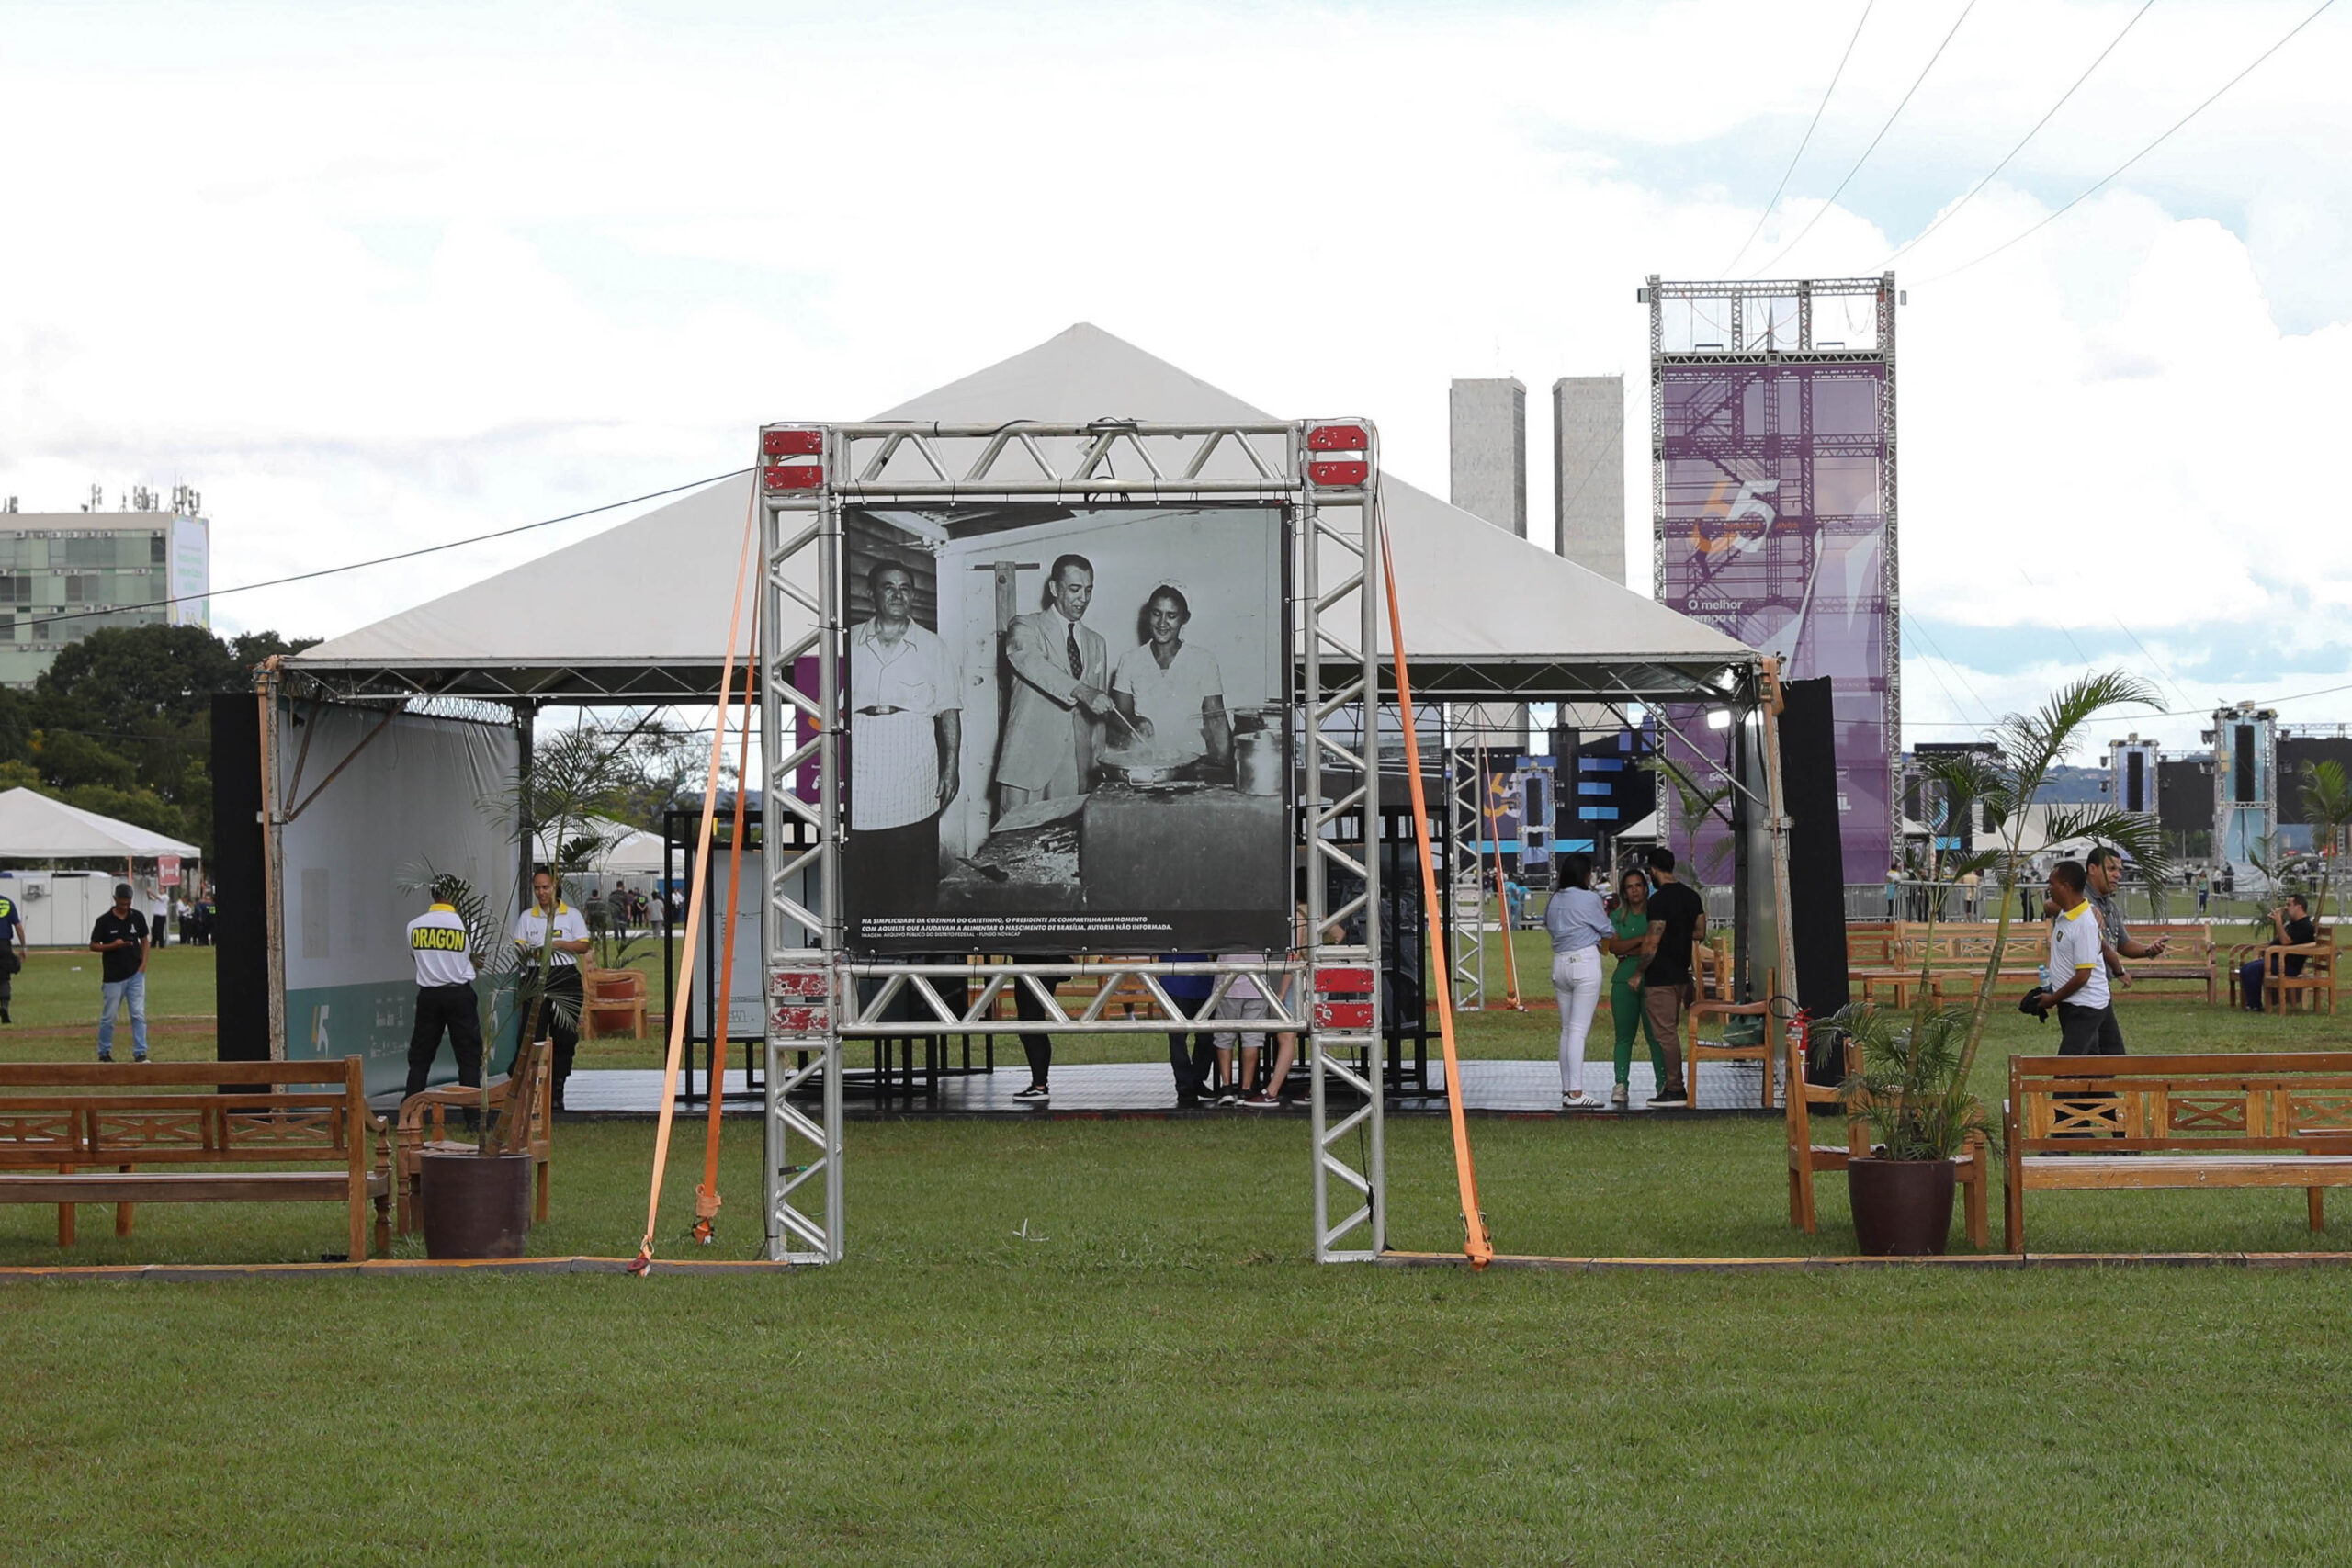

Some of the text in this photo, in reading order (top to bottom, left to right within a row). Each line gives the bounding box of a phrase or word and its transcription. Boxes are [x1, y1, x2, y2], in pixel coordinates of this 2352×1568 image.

[1688, 599, 1743, 610] O melhor
[1728, 610, 1737, 623] é
